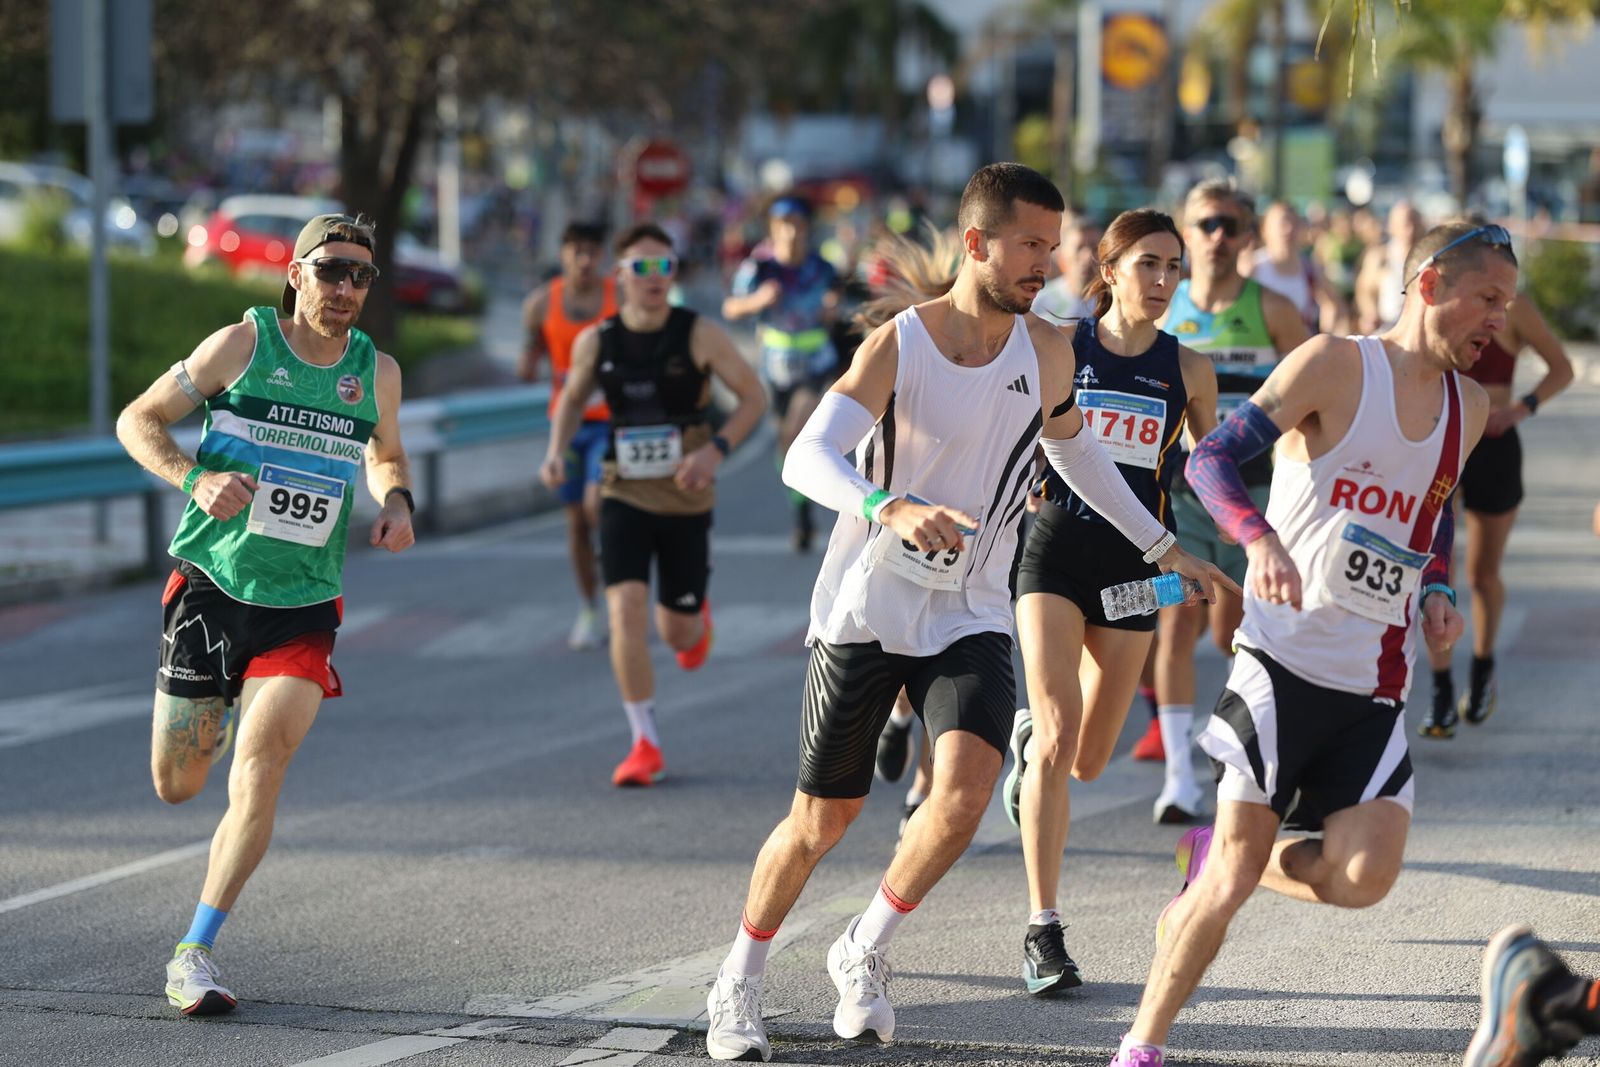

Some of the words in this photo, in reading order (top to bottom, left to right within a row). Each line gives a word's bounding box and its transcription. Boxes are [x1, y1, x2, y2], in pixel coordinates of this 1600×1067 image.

[267, 405, 354, 436] ATLETISMO
[1084, 409, 1159, 445] 1718
[247, 423, 362, 461] TORREMOLINOS
[269, 488, 329, 524] 995
[1329, 478, 1416, 524] RON
[1345, 550, 1403, 596] 933
